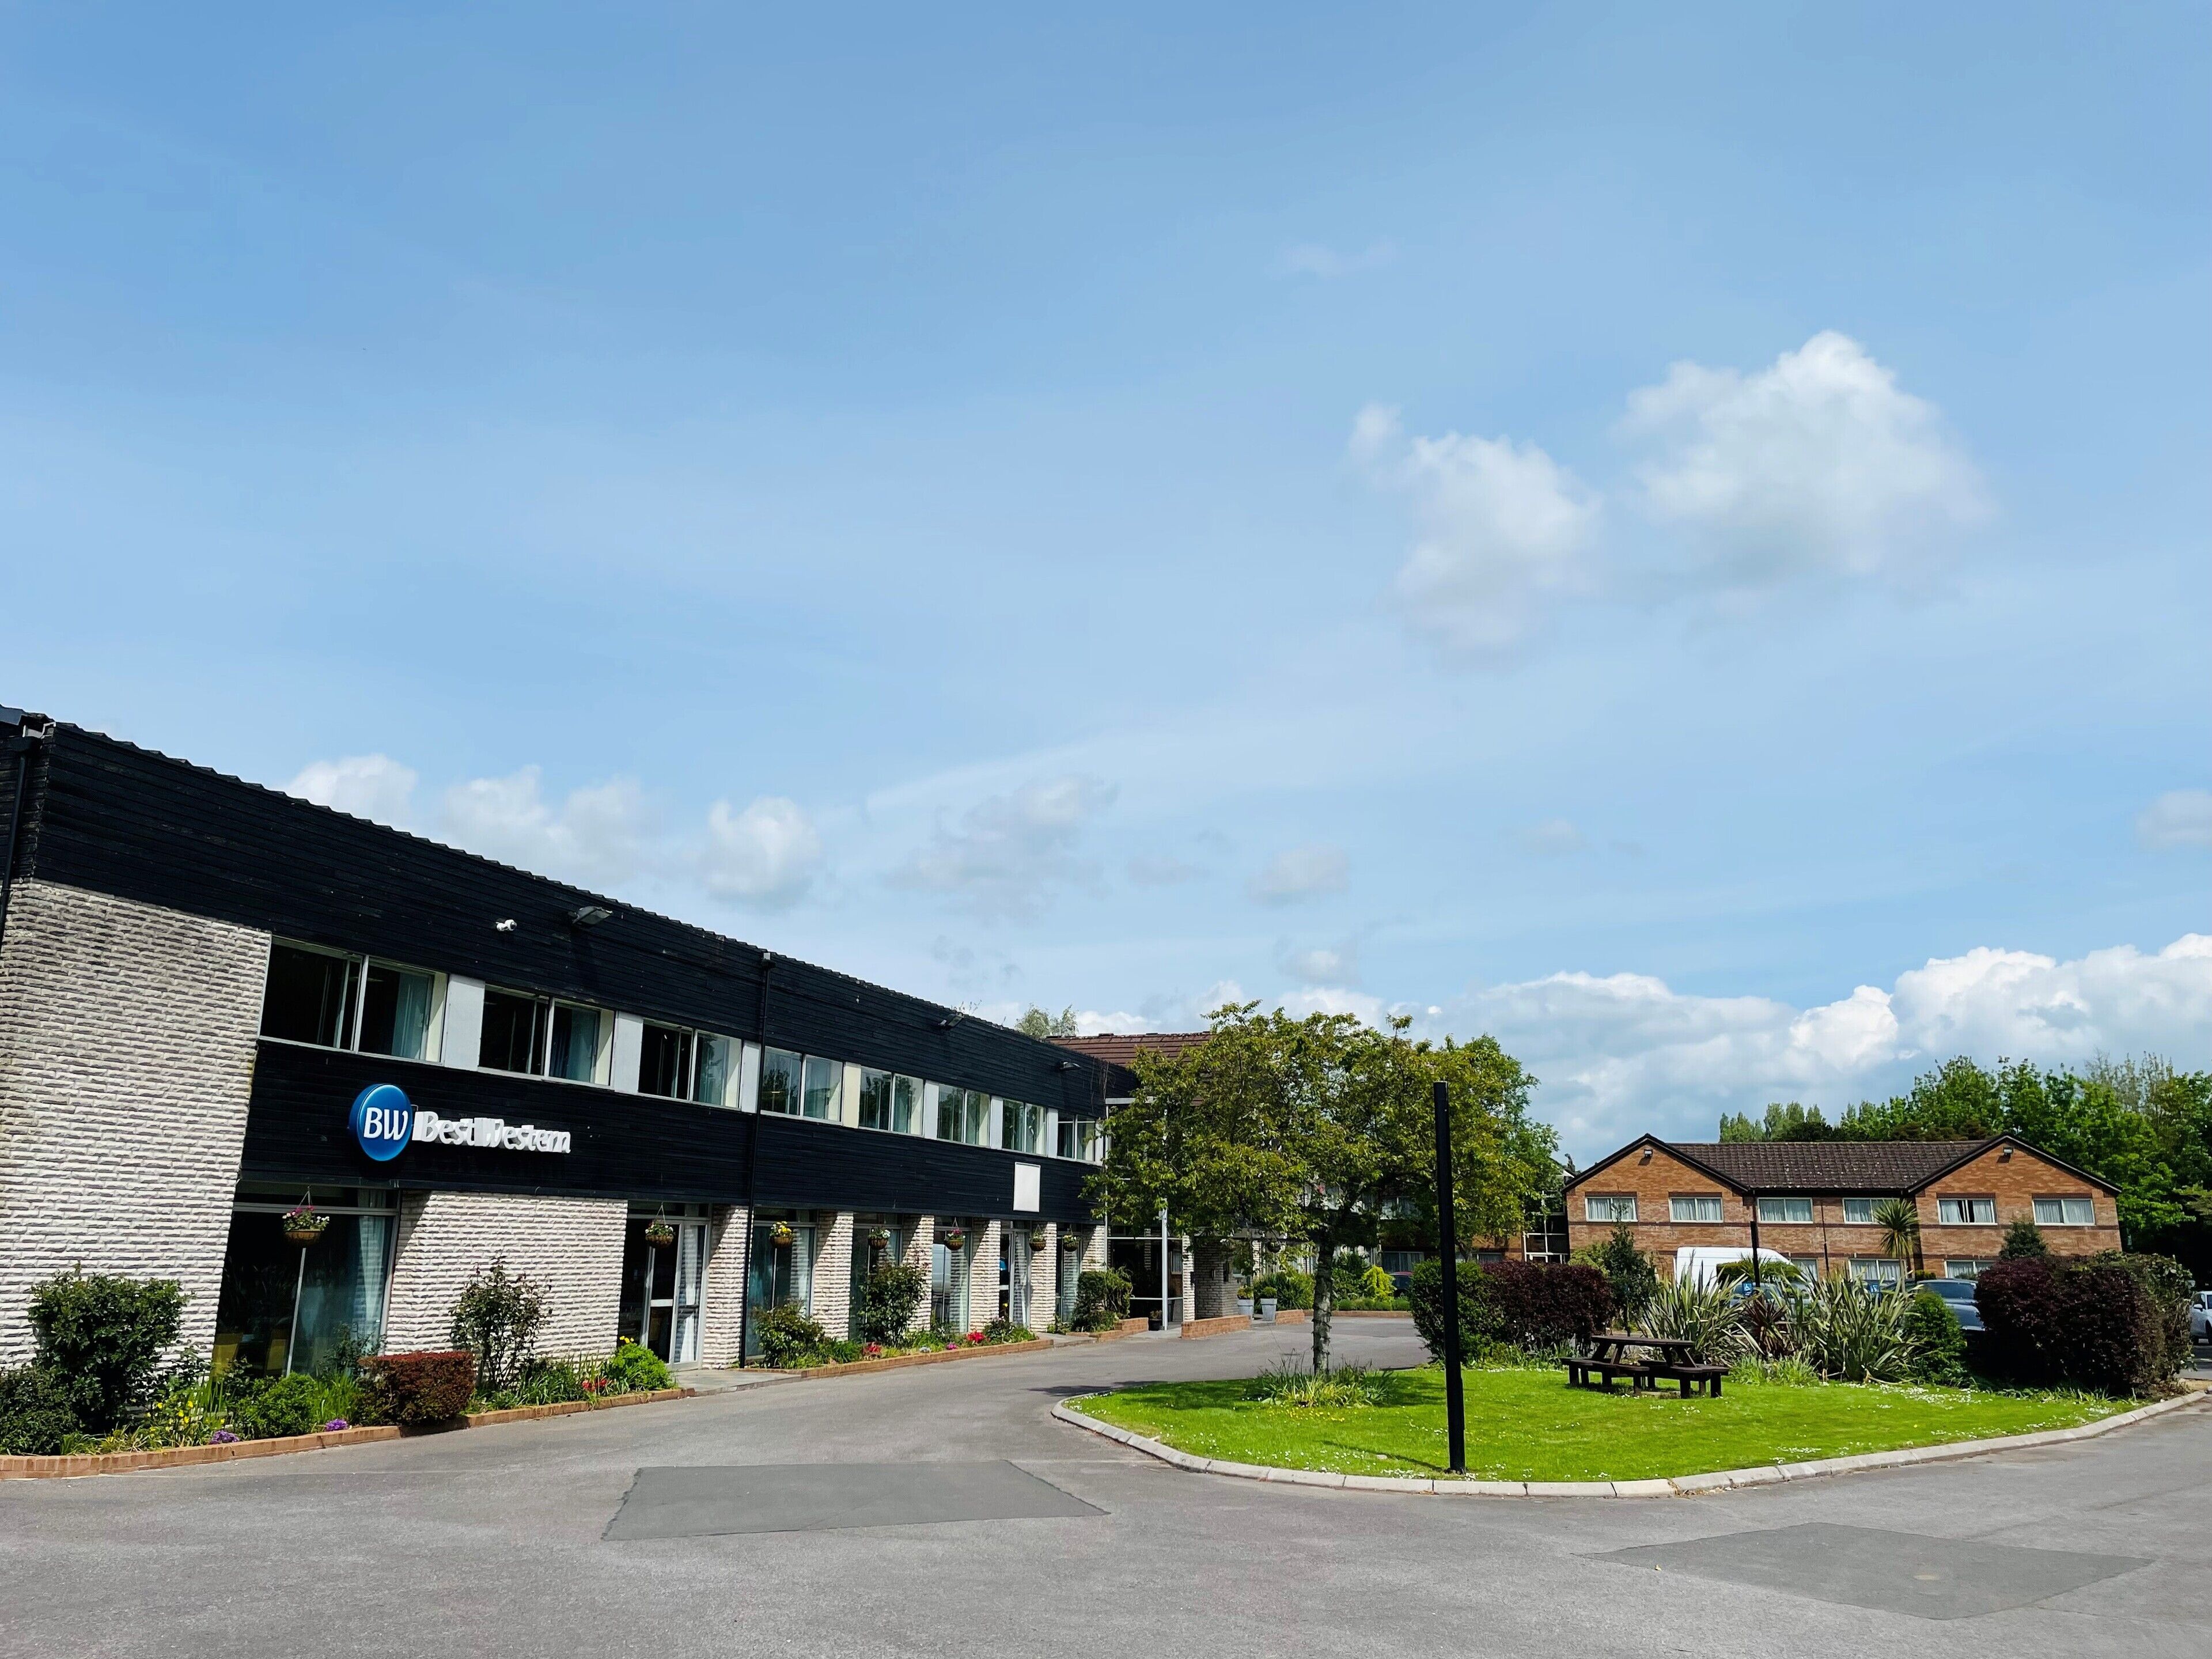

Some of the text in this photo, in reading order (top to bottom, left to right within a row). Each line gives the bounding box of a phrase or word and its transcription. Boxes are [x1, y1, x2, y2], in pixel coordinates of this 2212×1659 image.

[363, 1107, 408, 1141] BW
[412, 1111, 571, 1153] Best Western
